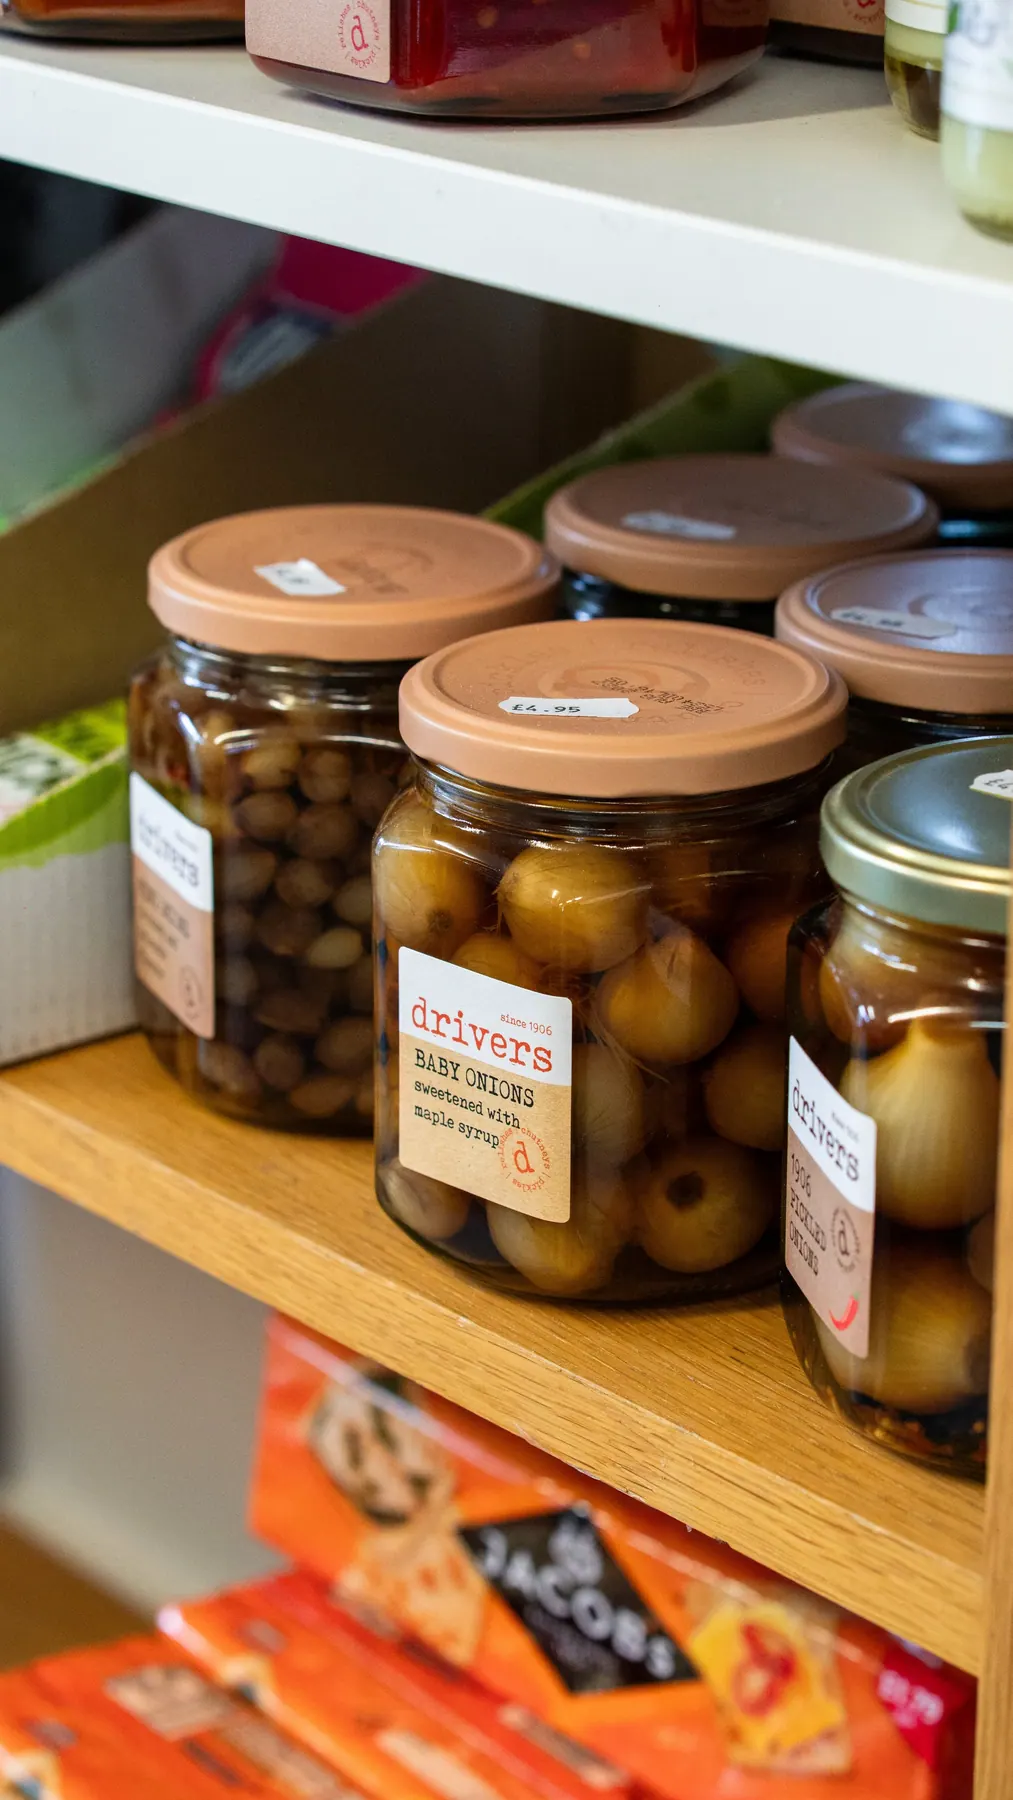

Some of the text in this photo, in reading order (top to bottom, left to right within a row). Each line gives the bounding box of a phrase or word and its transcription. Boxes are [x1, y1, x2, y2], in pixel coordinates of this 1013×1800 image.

[351, 15, 369, 51] d
[511, 703, 581, 714] £4.95
[411, 996, 553, 1074] drivers
[500, 1013, 553, 1036] since 1906
[414, 1047, 535, 1108] BABY ONIONS
[414, 1081, 521, 1130] sweetened with
[414, 1104, 500, 1149] maple syrup
[792, 1078, 860, 1182] drivers
[513, 1141, 536, 1174] d
[791, 1153, 811, 1198] 1906
[790, 1187, 827, 1251] PICKLED
[789, 1220, 819, 1276] ONIONS
